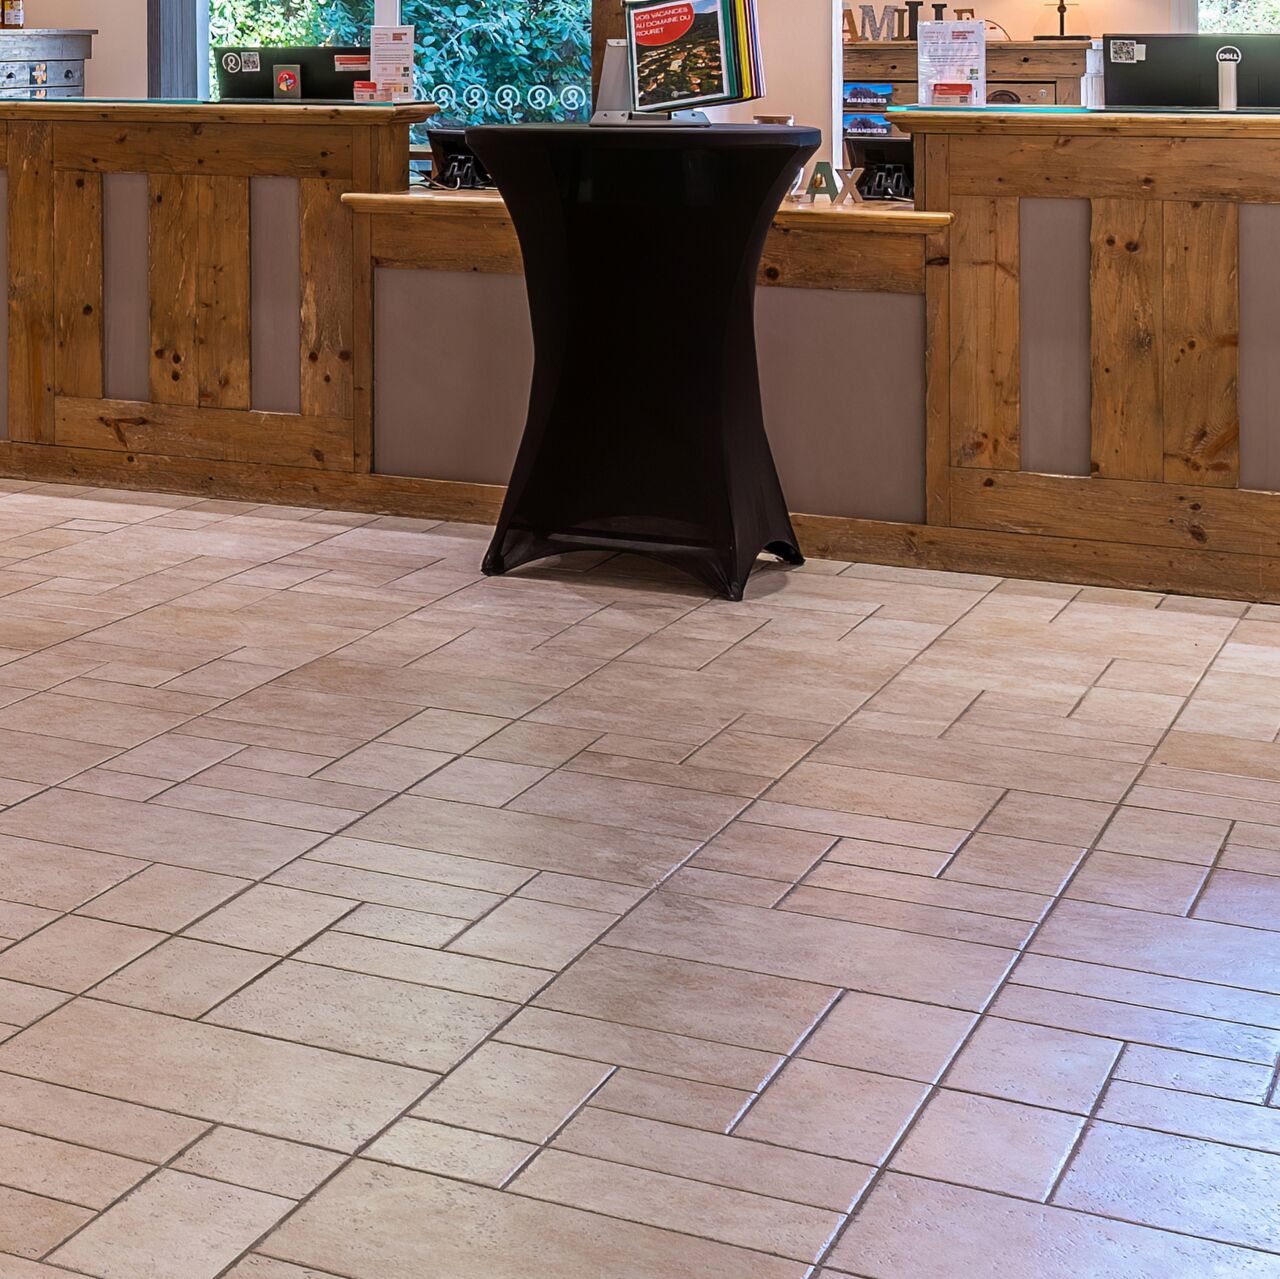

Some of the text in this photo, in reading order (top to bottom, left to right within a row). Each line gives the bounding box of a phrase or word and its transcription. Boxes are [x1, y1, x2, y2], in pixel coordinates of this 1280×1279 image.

[635, 6, 689, 21] VOS VACANCES
[646, 16, 679, 28] DOMAINE
[679, 14, 691, 22] DU
[842, 1, 975, 41] AMIL
[635, 27, 664, 37] ROURET
[846, 96, 887, 104] AMANDIERS
